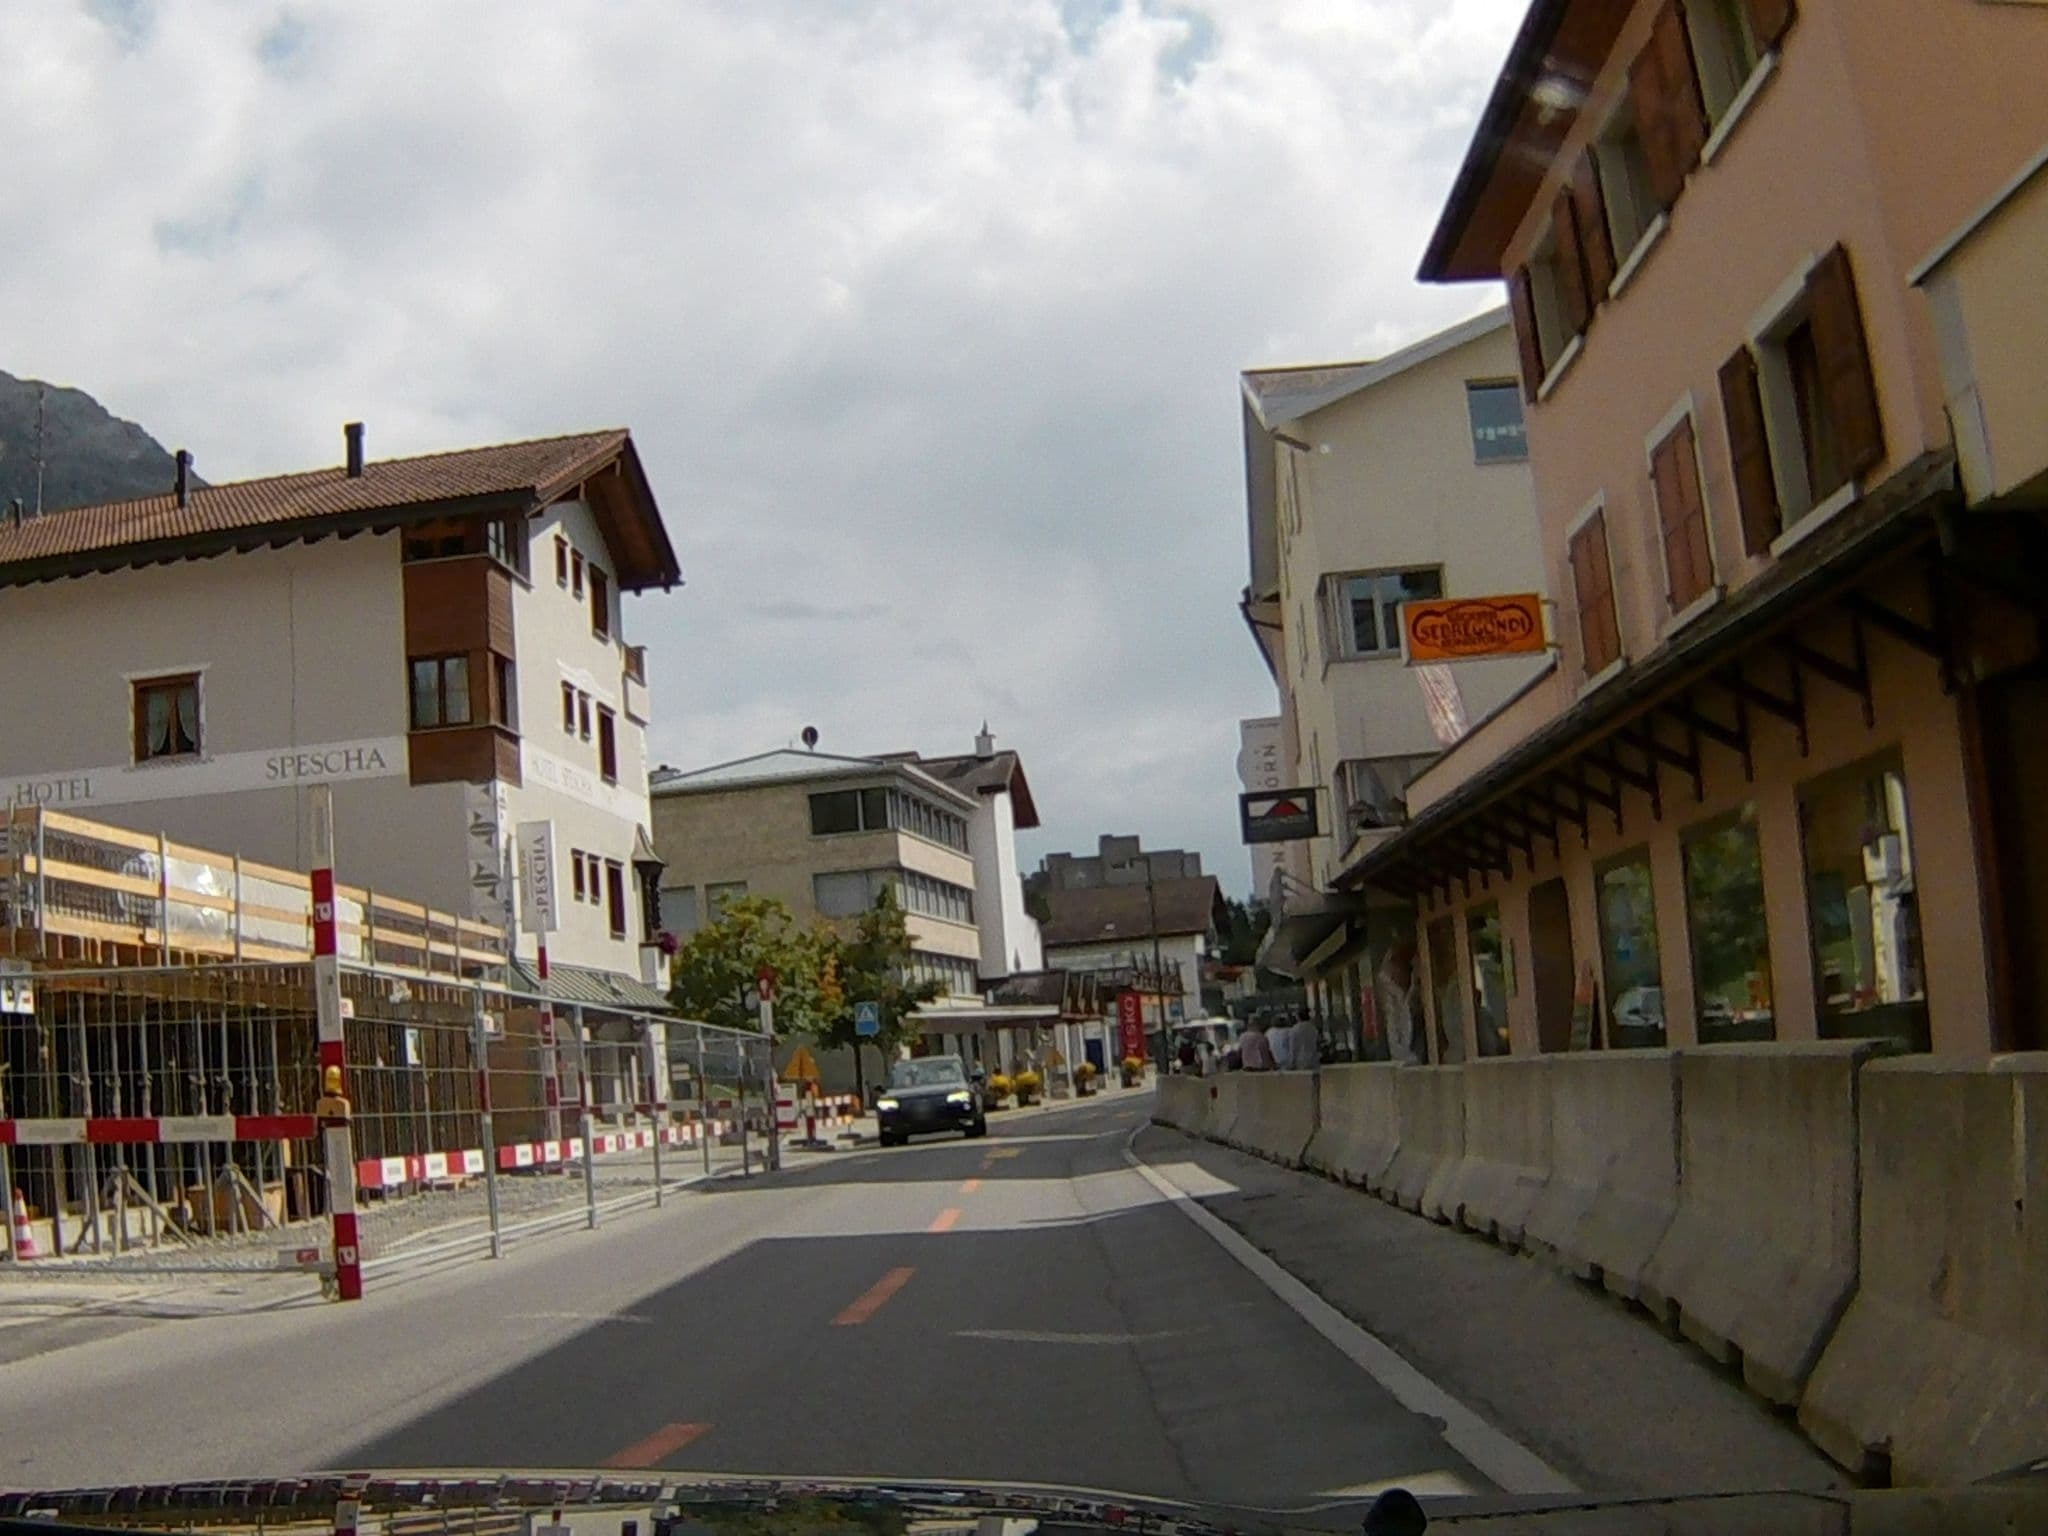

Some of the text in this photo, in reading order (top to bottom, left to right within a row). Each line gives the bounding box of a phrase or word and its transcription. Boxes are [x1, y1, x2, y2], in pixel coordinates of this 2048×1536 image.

[15, 748, 387, 804] HOTEL SPESCHA
[533, 835, 549, 915] SPESCHA
